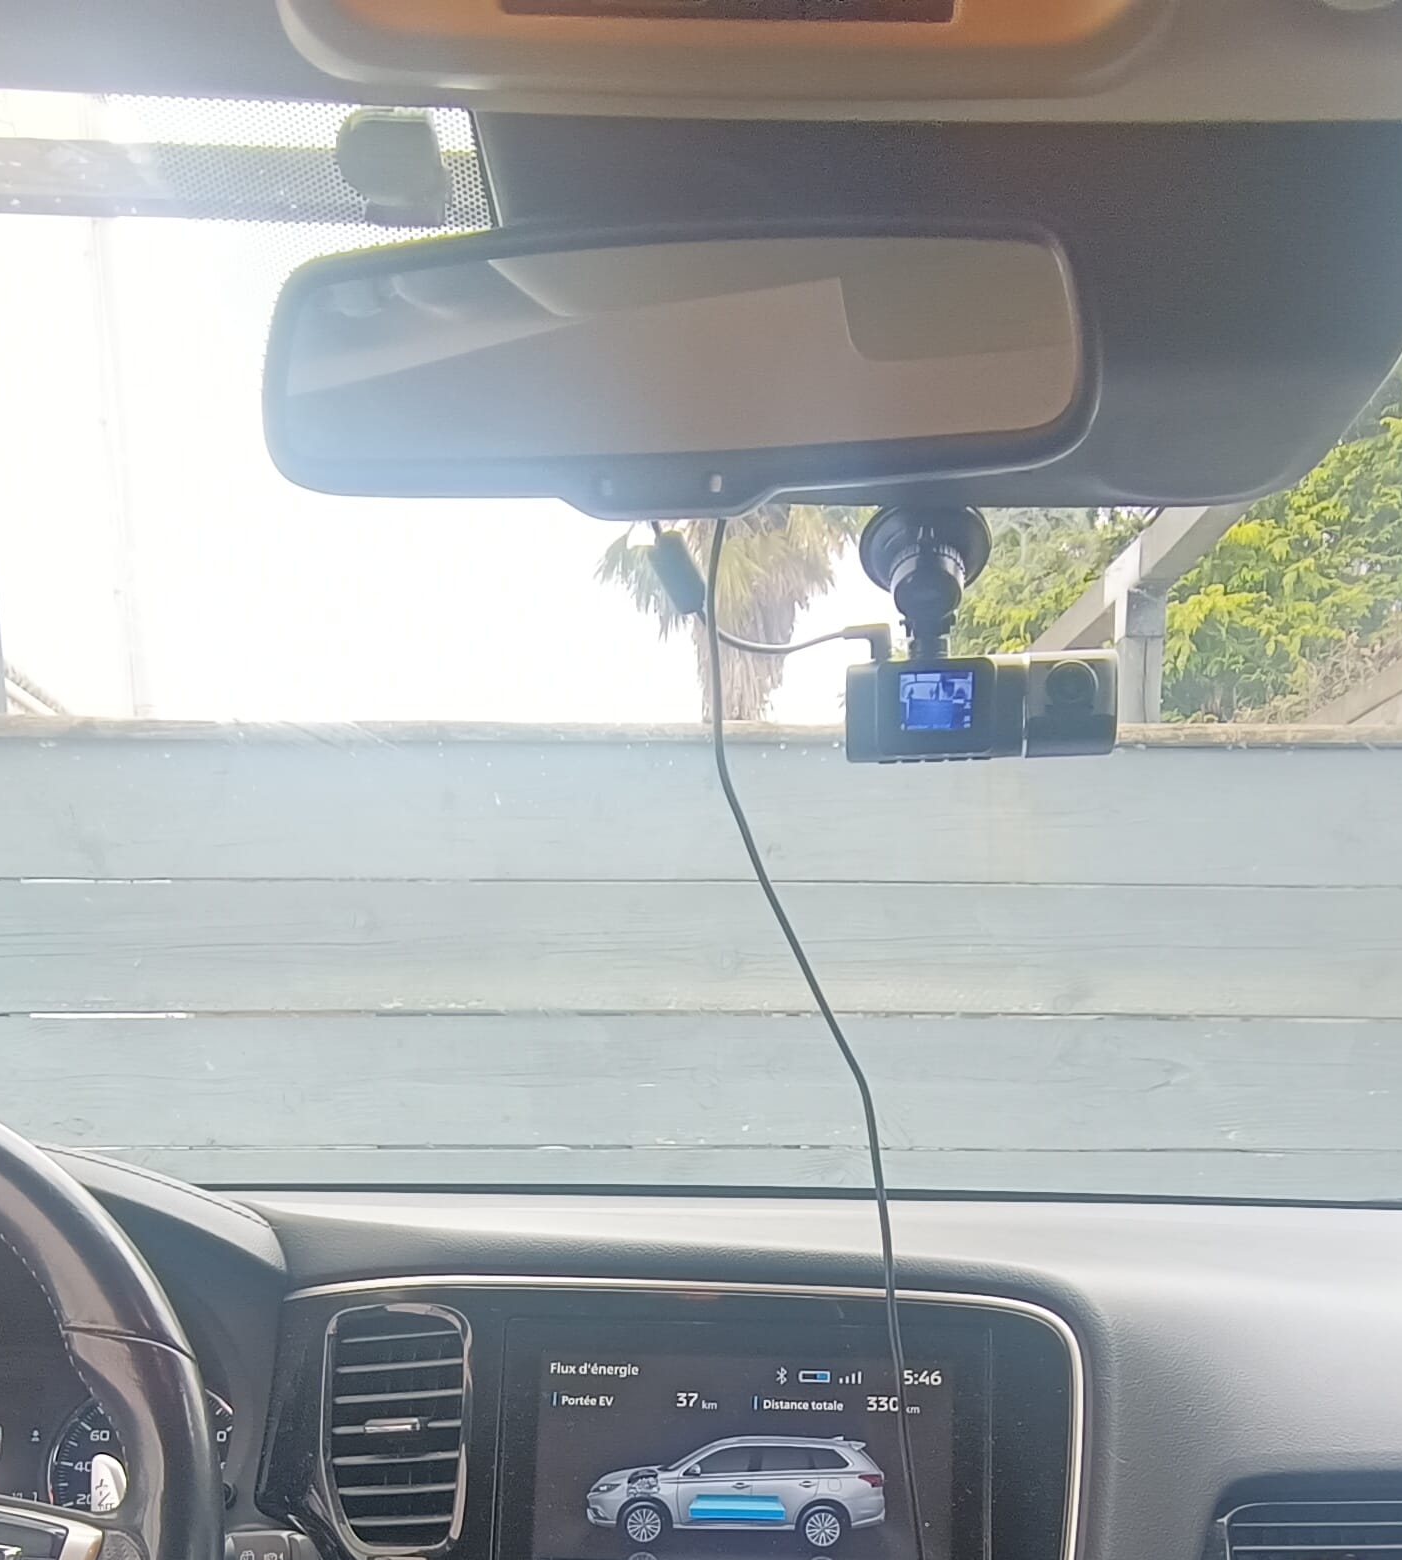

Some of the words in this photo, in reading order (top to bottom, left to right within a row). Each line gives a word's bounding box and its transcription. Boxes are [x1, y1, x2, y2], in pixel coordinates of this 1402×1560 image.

[550, 1362, 576, 1376] Flux
[578, 1363, 640, 1378] d'énergie
[561, 1395, 597, 1407] Portée
[599, 1396, 615, 1407] EV
[676, 1392, 699, 1408] 37
[701, 1400, 718, 1411] km
[763, 1399, 809, 1411] Distance
[811, 1400, 845, 1412] totale
[89, 1430, 110, 1442] 60
